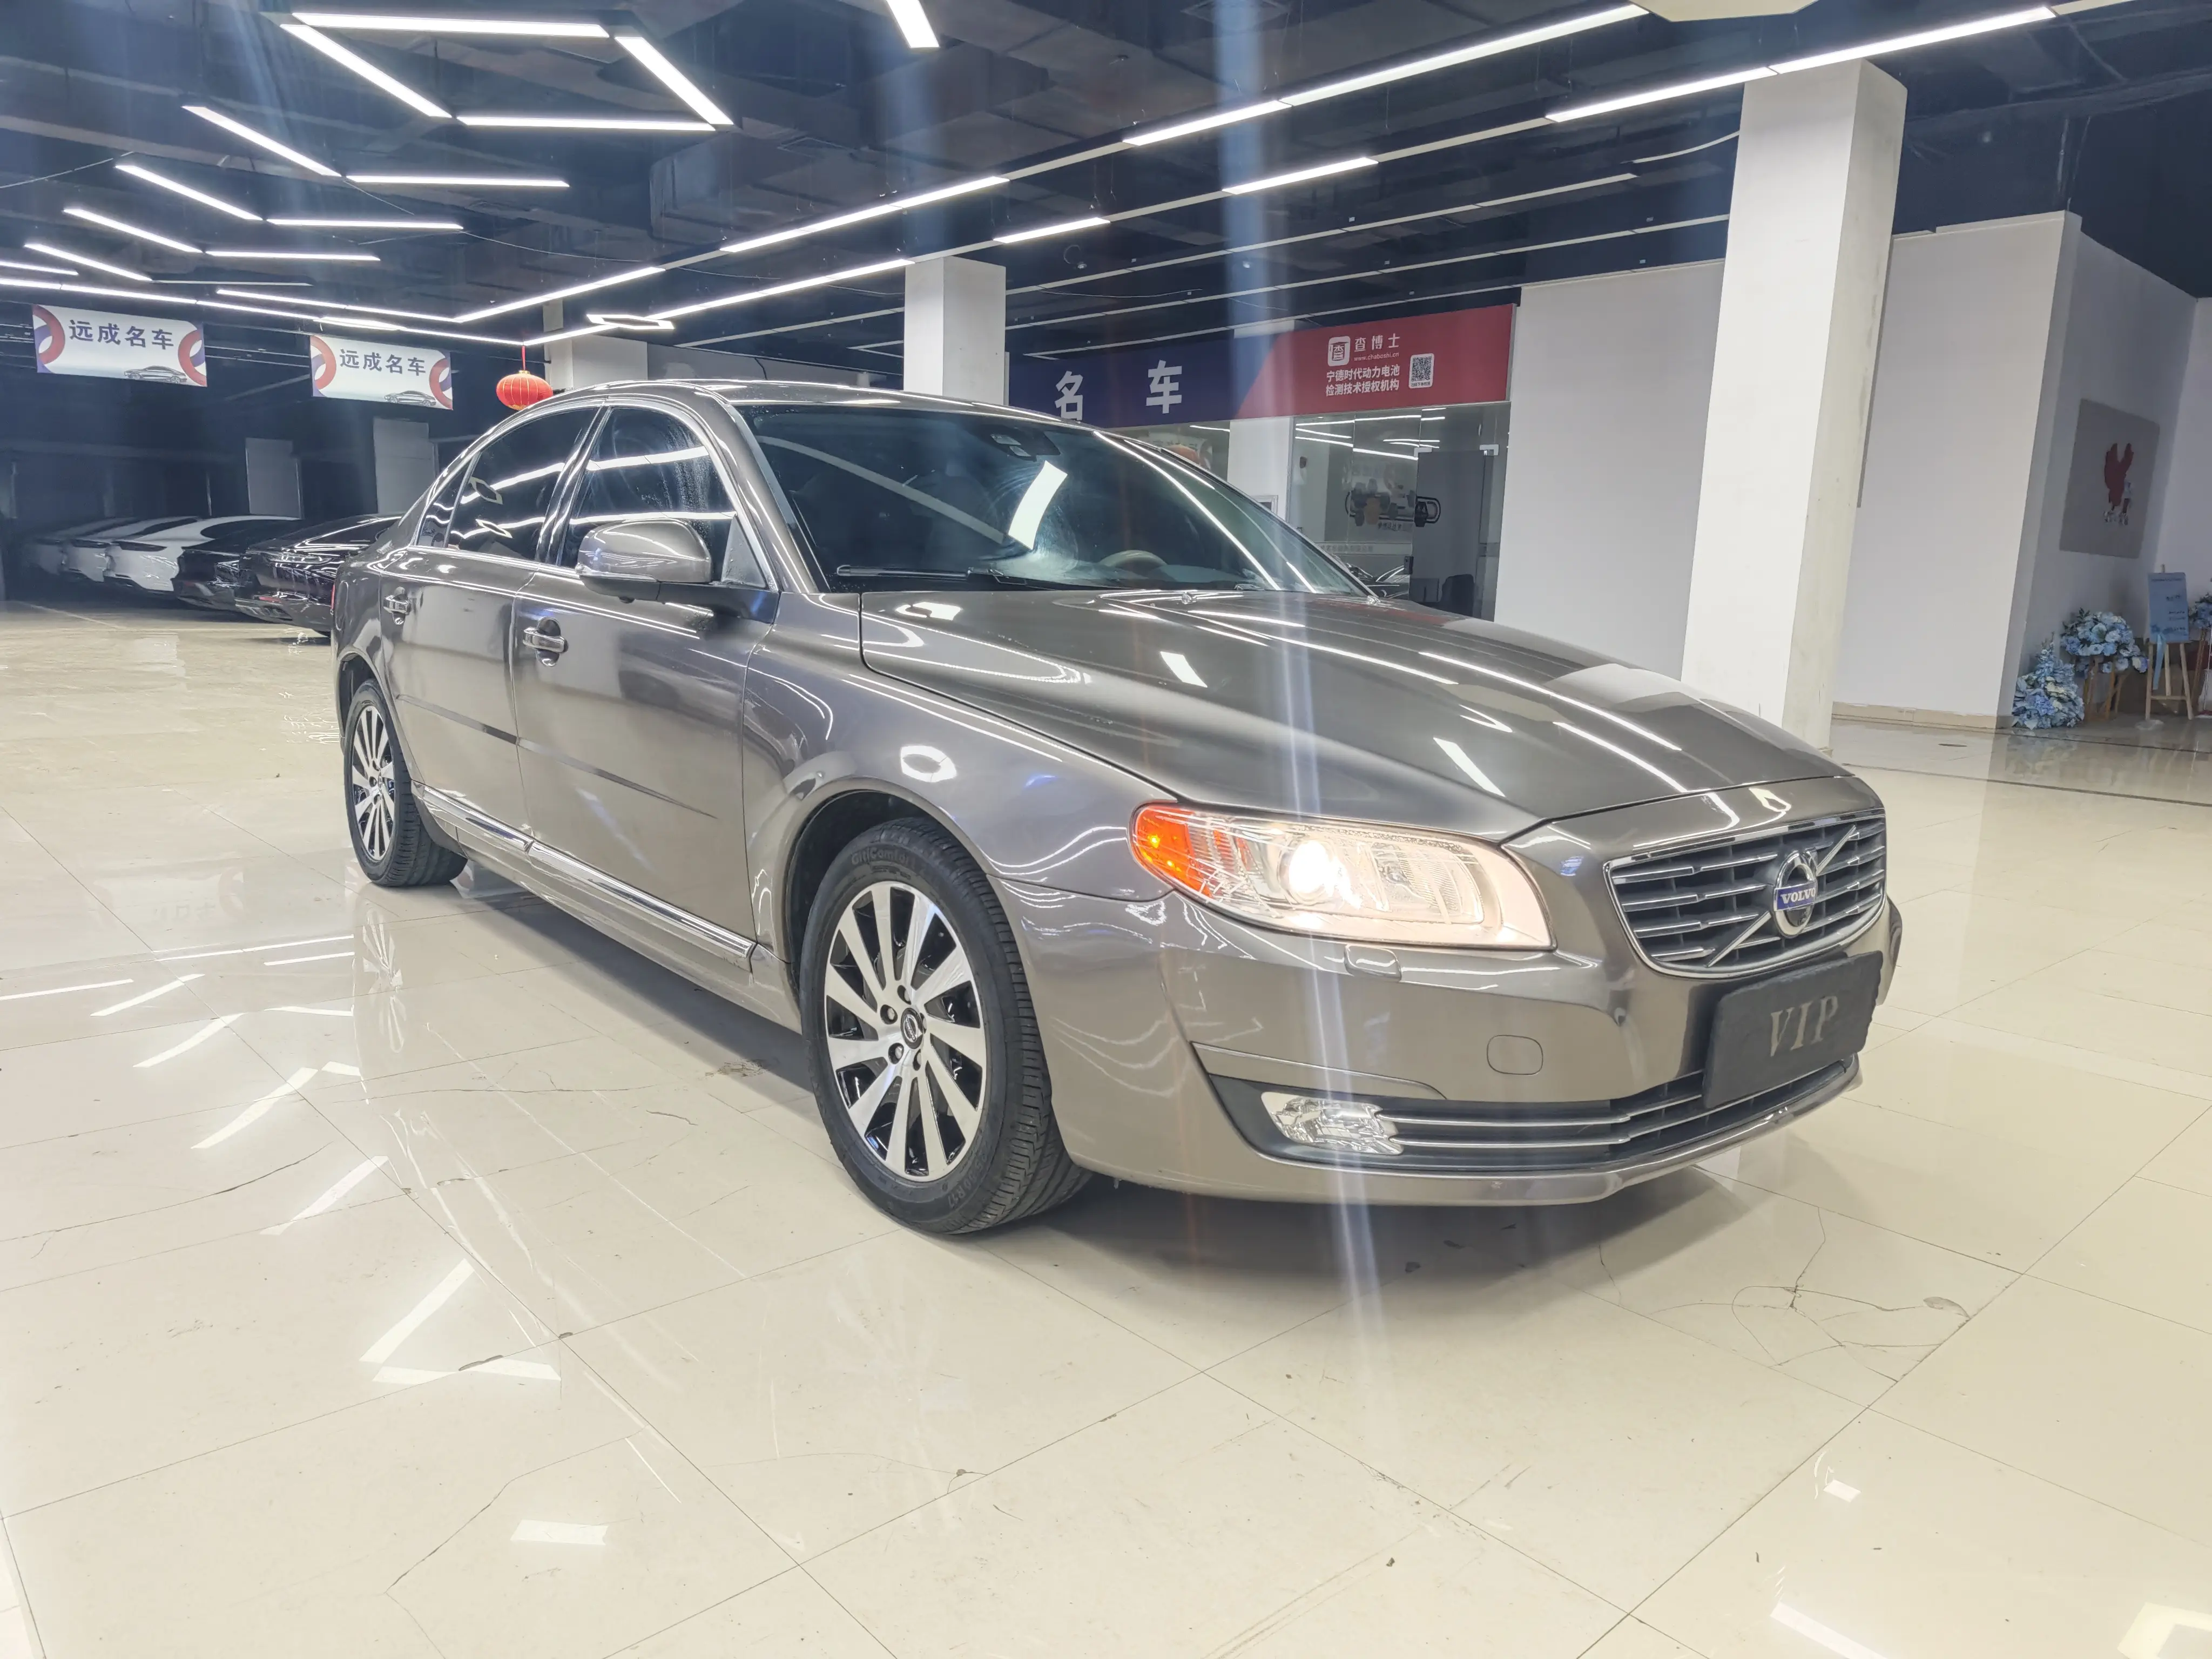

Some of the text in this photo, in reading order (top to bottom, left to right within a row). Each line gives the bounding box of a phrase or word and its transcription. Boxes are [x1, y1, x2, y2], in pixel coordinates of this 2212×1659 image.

[69, 319, 174, 349] 远成名车
[1354, 333, 1401, 352] 查博士
[339, 348, 426, 376] 远成名车
[1353, 352, 1400, 362] www.chaboshi.cn
[1326, 364, 1400, 382] 宁德时代动力电池
[1325, 380, 1400, 397] 检测技术授权机构
[1781, 887, 1816, 905] VOLVO
[1770, 996, 1839, 1057] VIP
